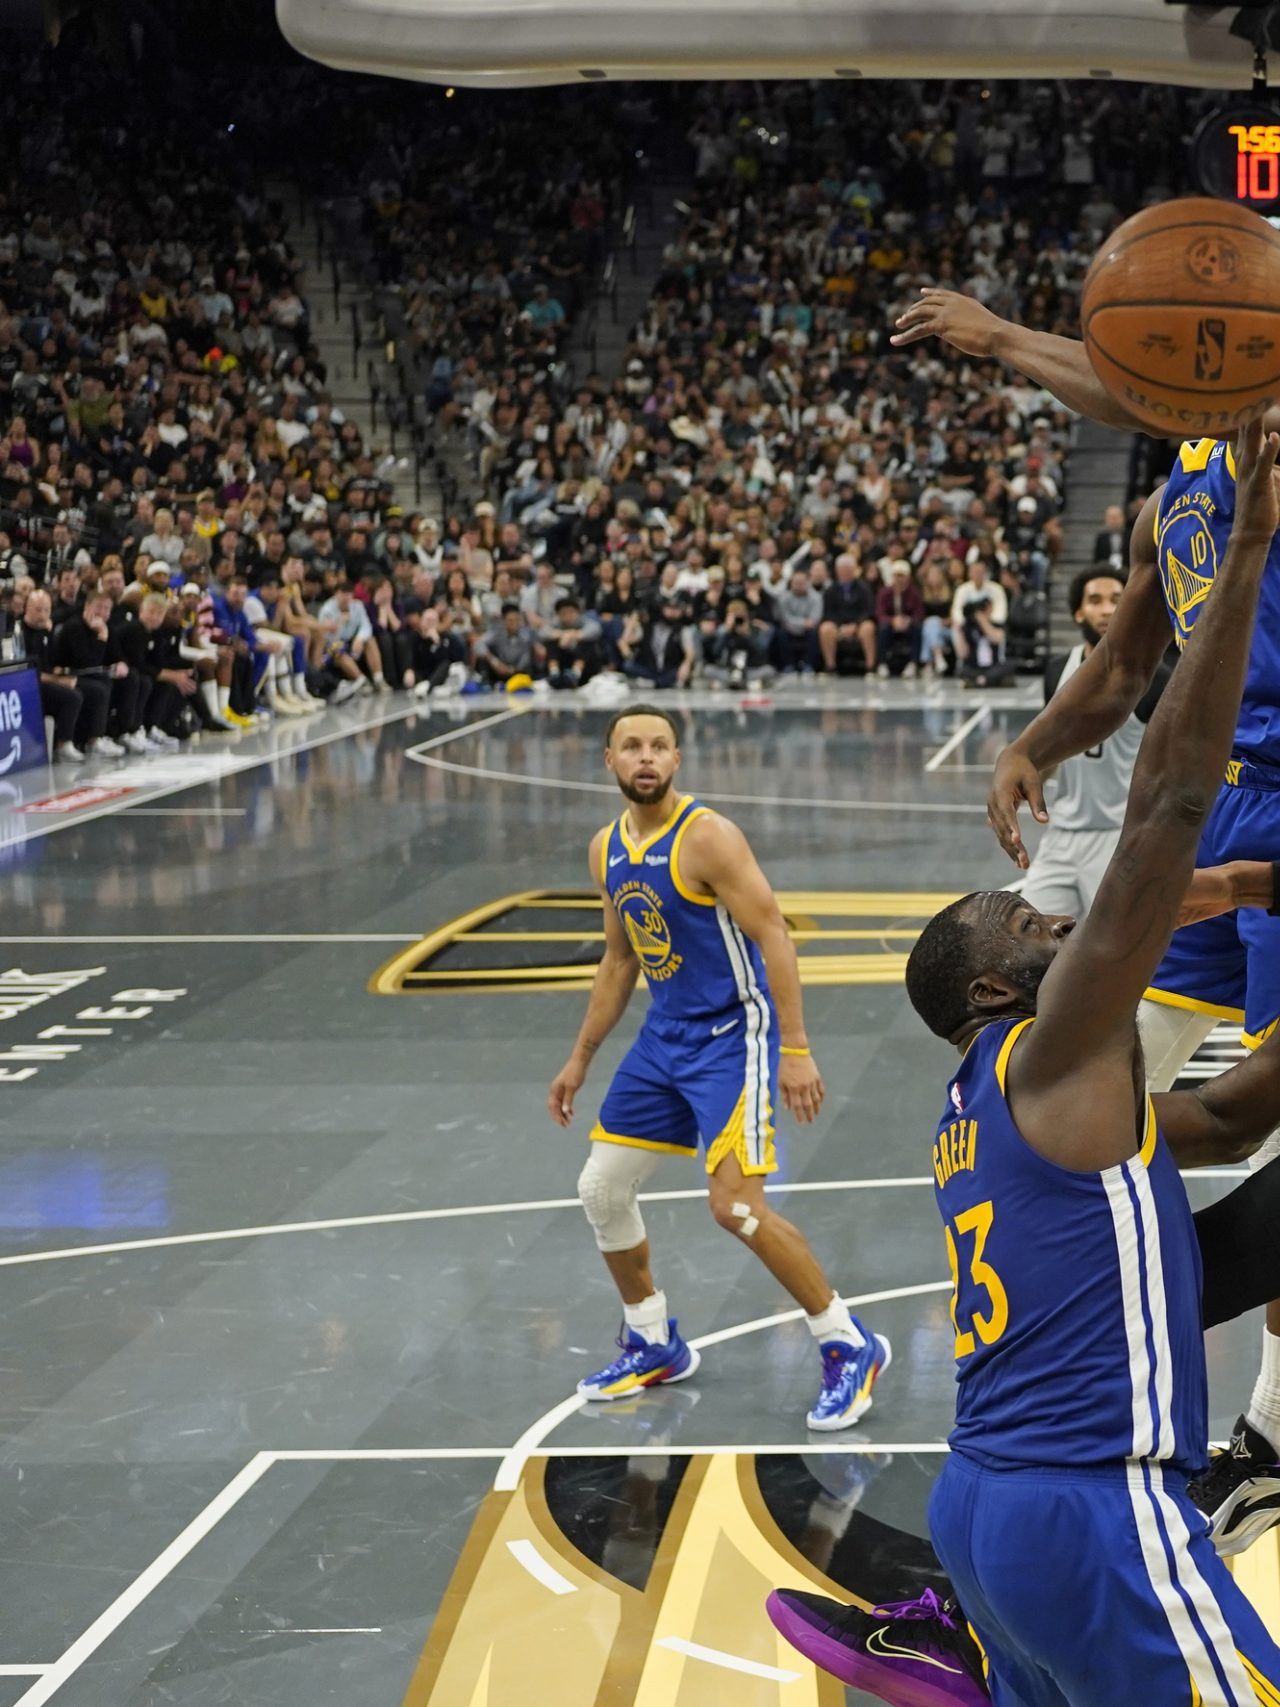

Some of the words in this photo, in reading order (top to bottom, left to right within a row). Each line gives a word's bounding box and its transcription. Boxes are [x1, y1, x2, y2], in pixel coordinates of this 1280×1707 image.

[1237, 153, 1279, 199] 10
[1192, 491, 1217, 517] STATE
[1190, 530, 1207, 569] 10
[640, 910, 663, 934] 30
[932, 1118, 978, 1190] GREEN
